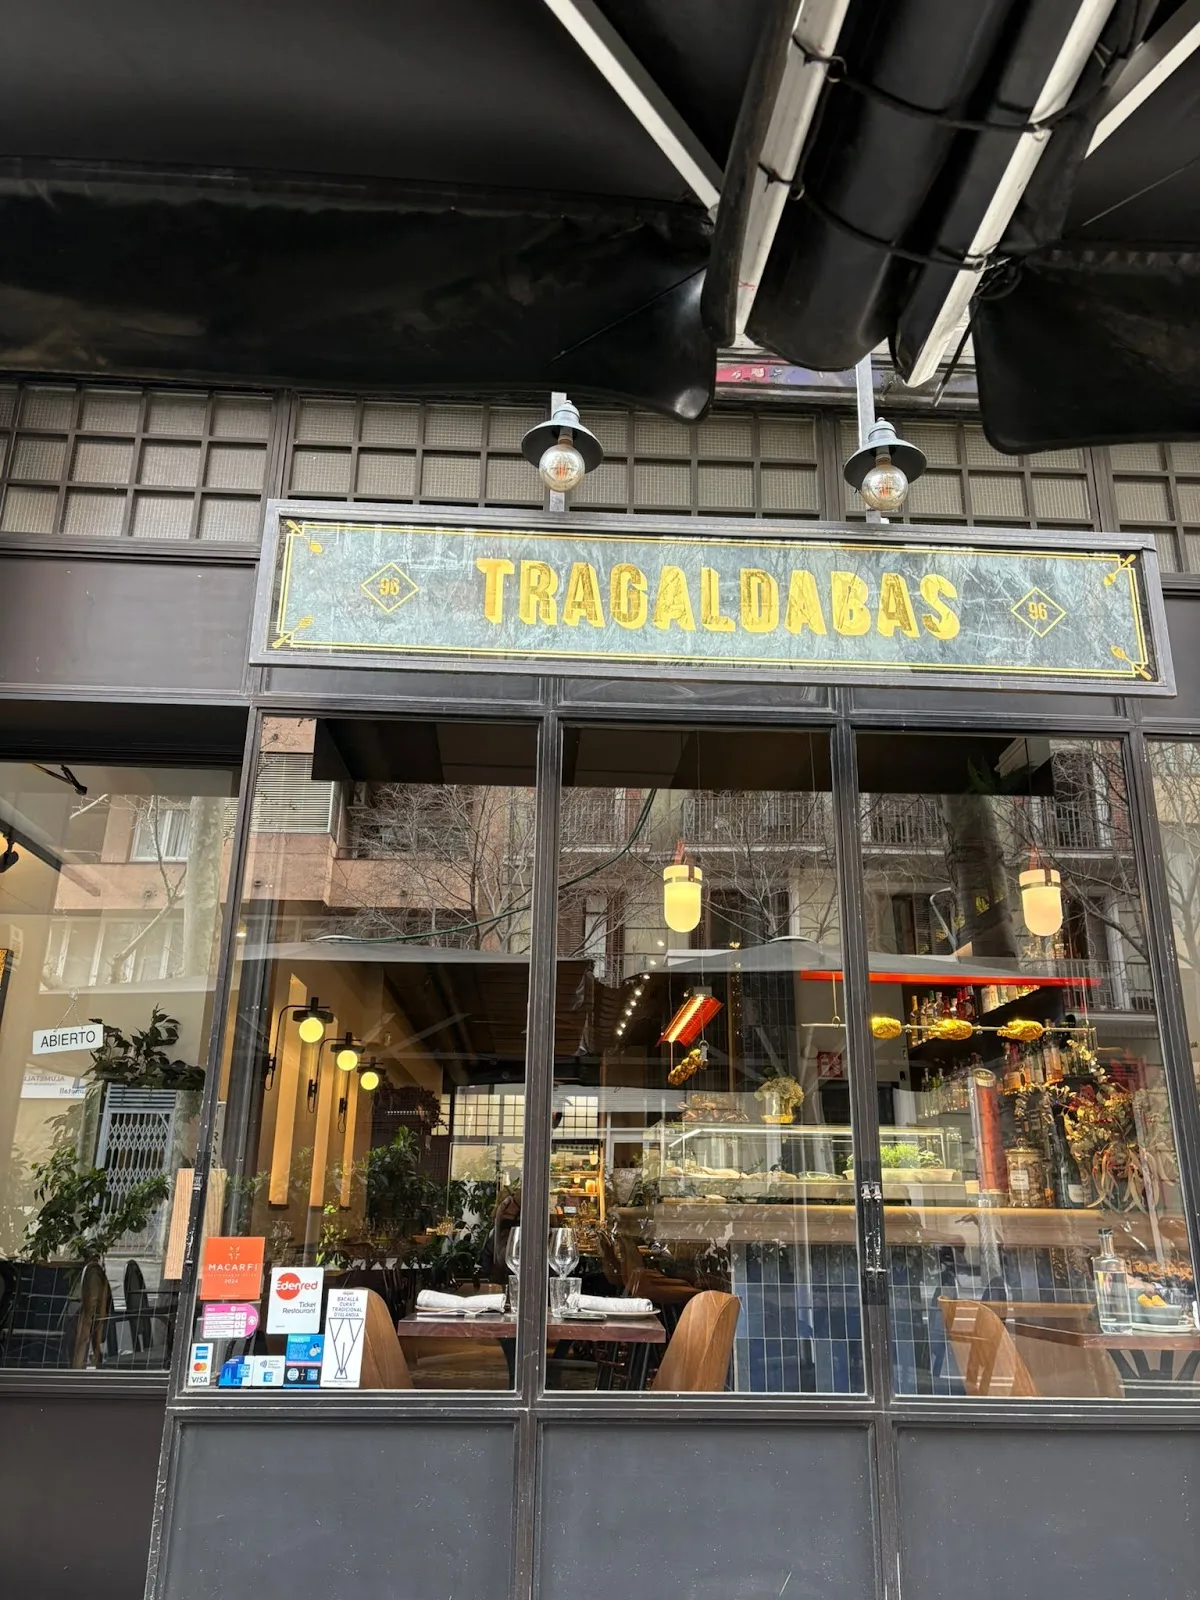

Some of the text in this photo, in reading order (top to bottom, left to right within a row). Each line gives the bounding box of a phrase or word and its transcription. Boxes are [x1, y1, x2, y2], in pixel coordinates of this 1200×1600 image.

[378, 576, 401, 597] 96
[476, 557, 961, 640] TRAGALDABAS
[1027, 601, 1048, 621] 96
[40, 1030, 96, 1048] ABIERTO
[208, 1263, 258, 1271] MACARFI
[276, 1280, 319, 1291] Edenred
